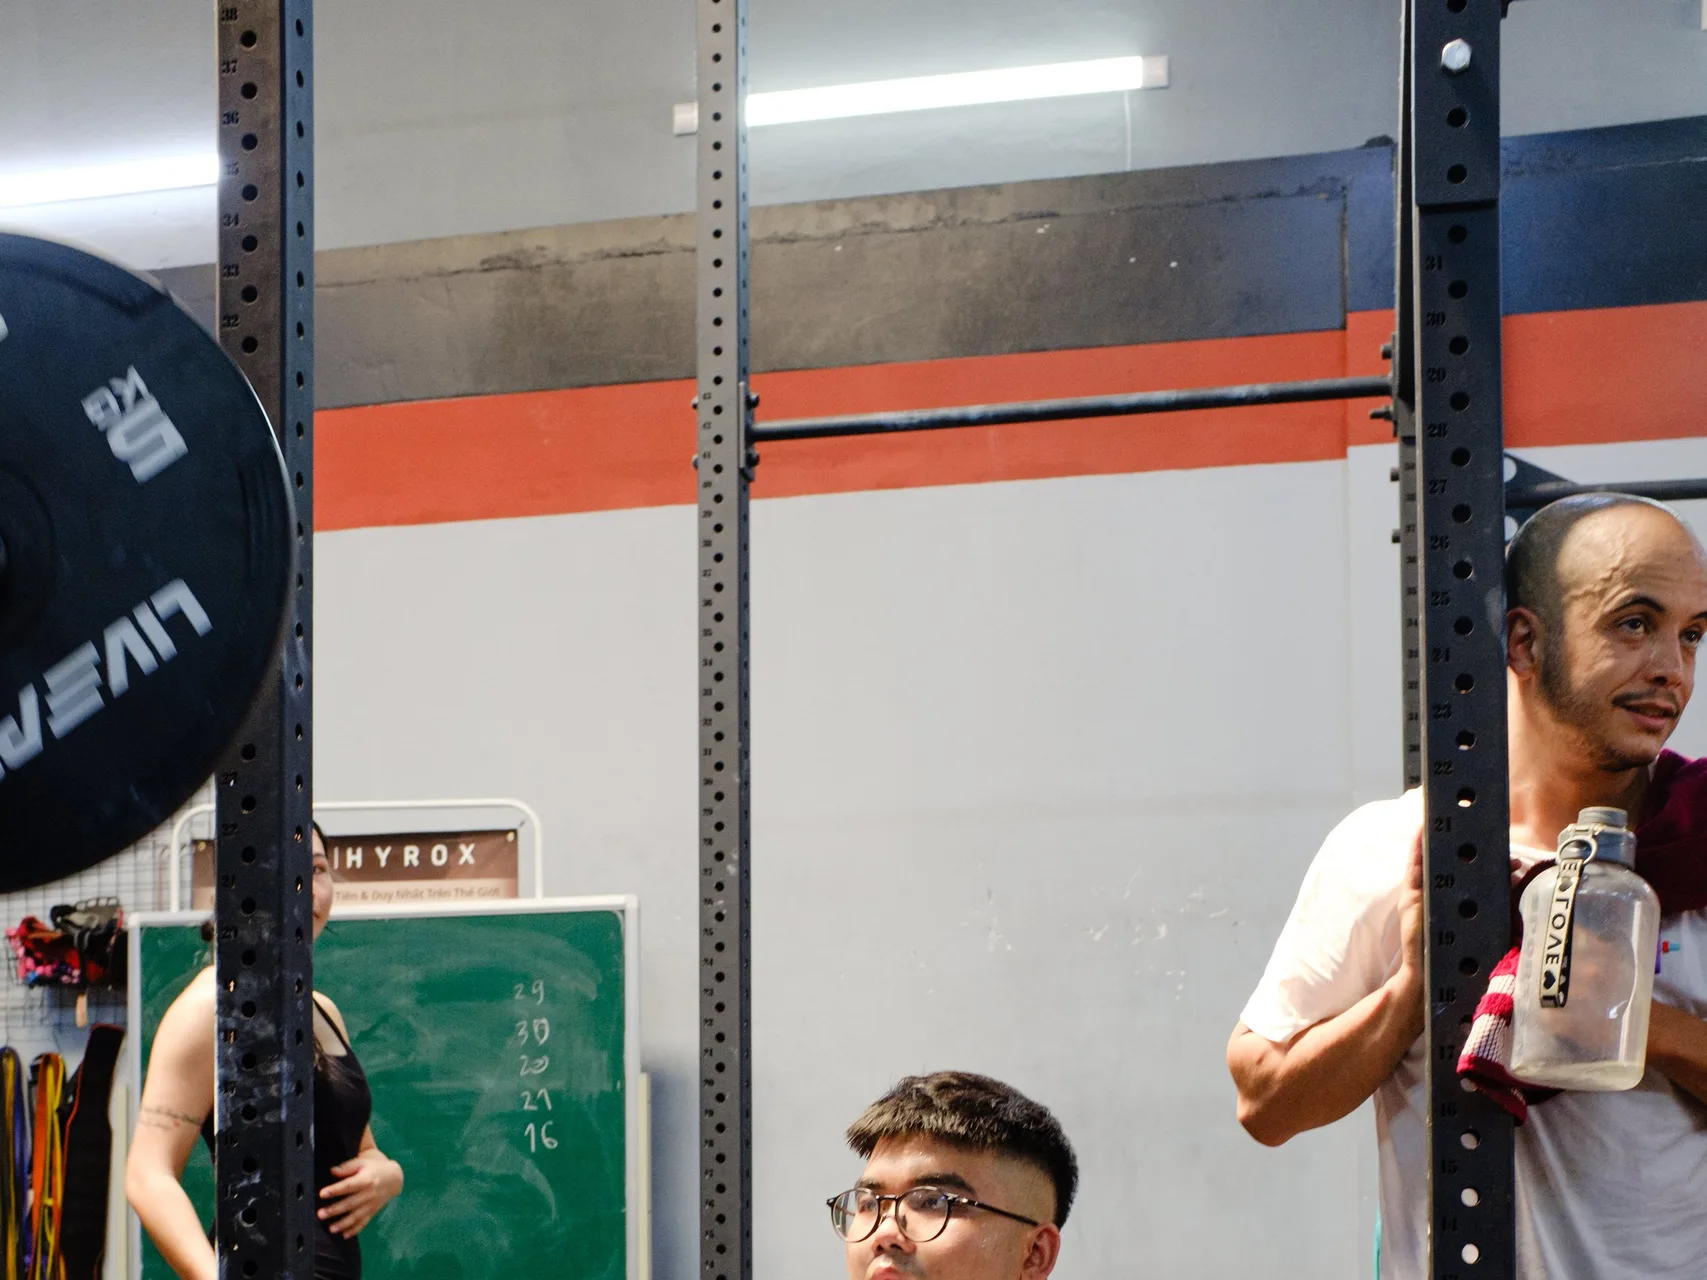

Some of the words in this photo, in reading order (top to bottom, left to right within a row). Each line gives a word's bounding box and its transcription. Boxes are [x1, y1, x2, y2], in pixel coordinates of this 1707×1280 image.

[222, 60, 237, 73] 37
[223, 315, 239, 327] 32
[80, 364, 152, 431] KG
[106, 393, 189, 484] 5
[1429, 479, 1446, 493] 27
[0, 578, 213, 783] LIVEP
[1433, 761, 1453, 774] 22
[1435, 817, 1451, 831] 21
[346, 843, 475, 869] HYROX
[371, 889, 393, 903] Duy
[1545, 898, 1570, 965] LOVE
[514, 980, 544, 1005] 29
[517, 1017, 550, 1046] 30
[523, 1120, 559, 1152] 16
